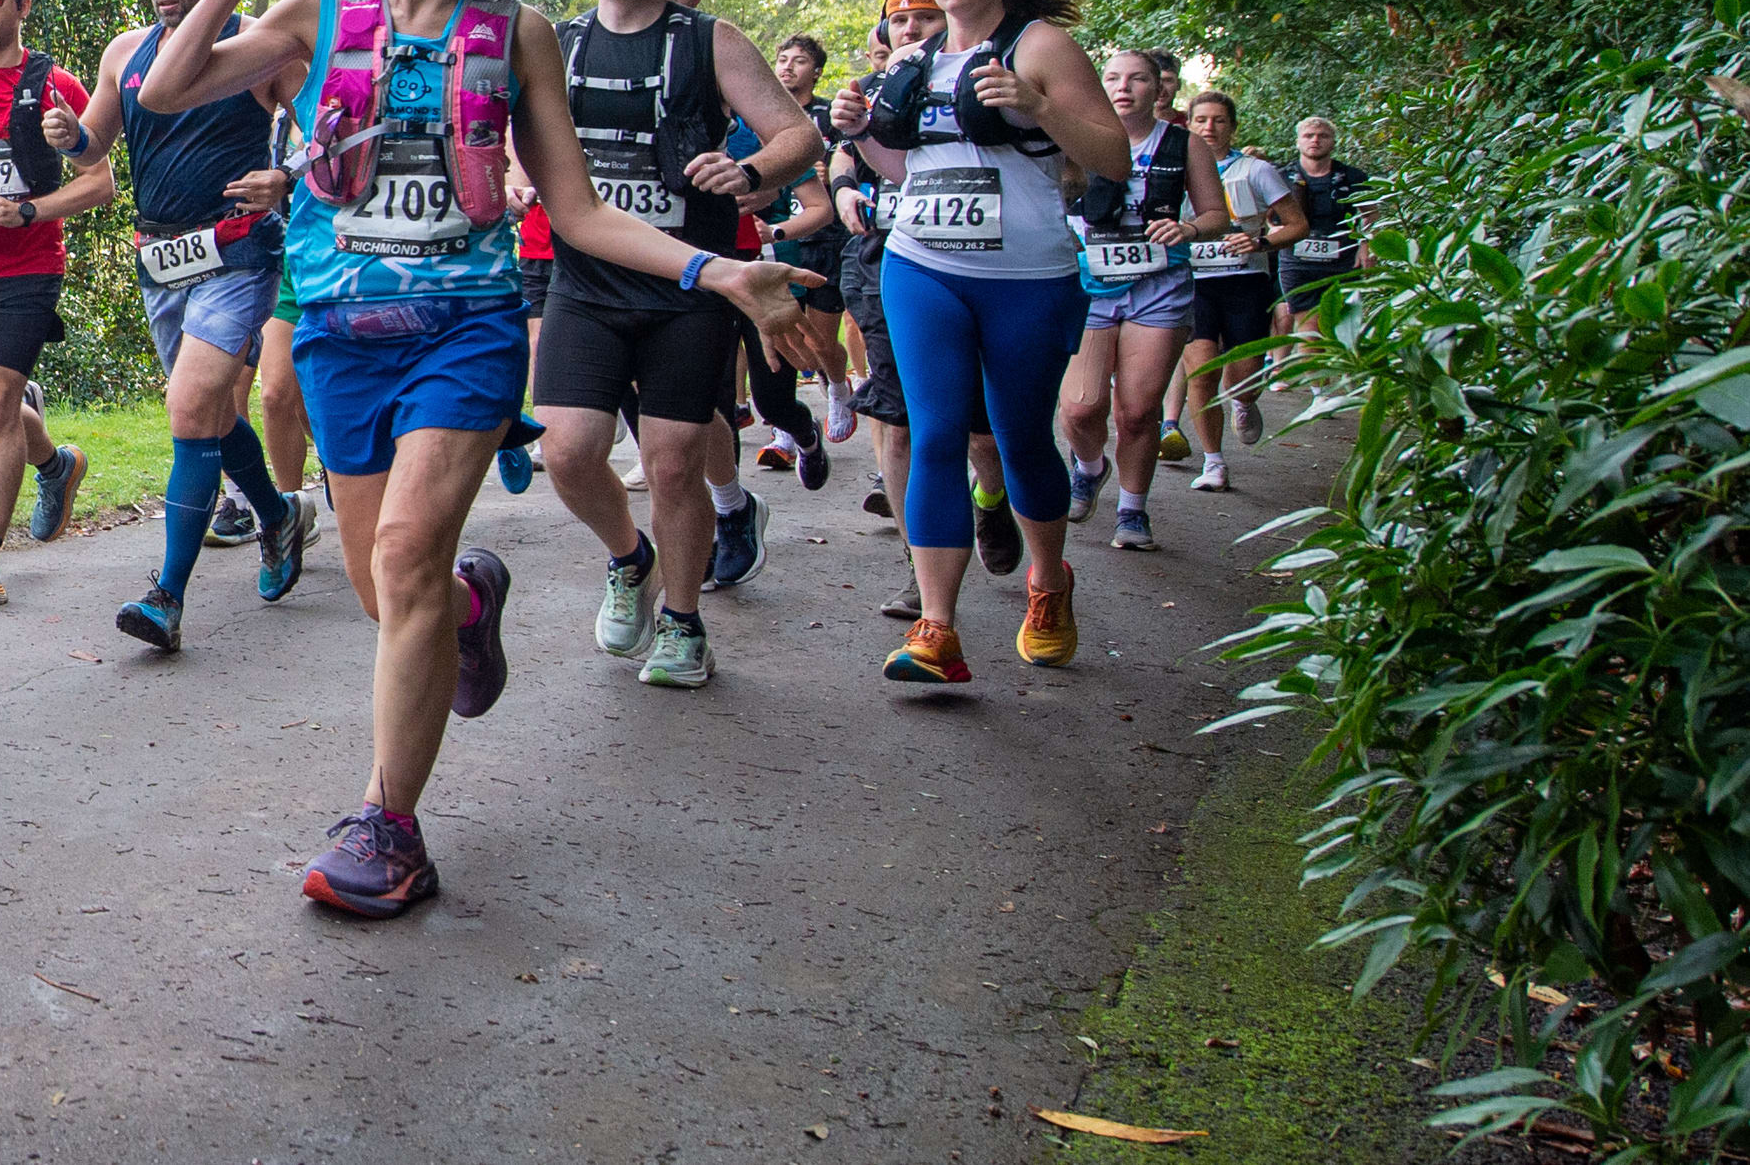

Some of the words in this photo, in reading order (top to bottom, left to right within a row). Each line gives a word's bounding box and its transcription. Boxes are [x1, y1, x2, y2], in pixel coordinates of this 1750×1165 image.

[594, 159, 610, 169] Uber
[611, 161, 629, 169] Boat
[352, 179, 453, 222] 2109
[597, 181, 672, 214] 2033
[911, 196, 985, 226] 2126
[152, 234, 207, 272] 2328
[351, 241, 420, 255] RICHMOND
[423, 242, 449, 255] 26.2
[921, 241, 963, 250] CHMOND
[965, 241, 986, 250] 26.2
[1101, 243, 1153, 266] 1581
[1304, 240, 1330, 253] 738
